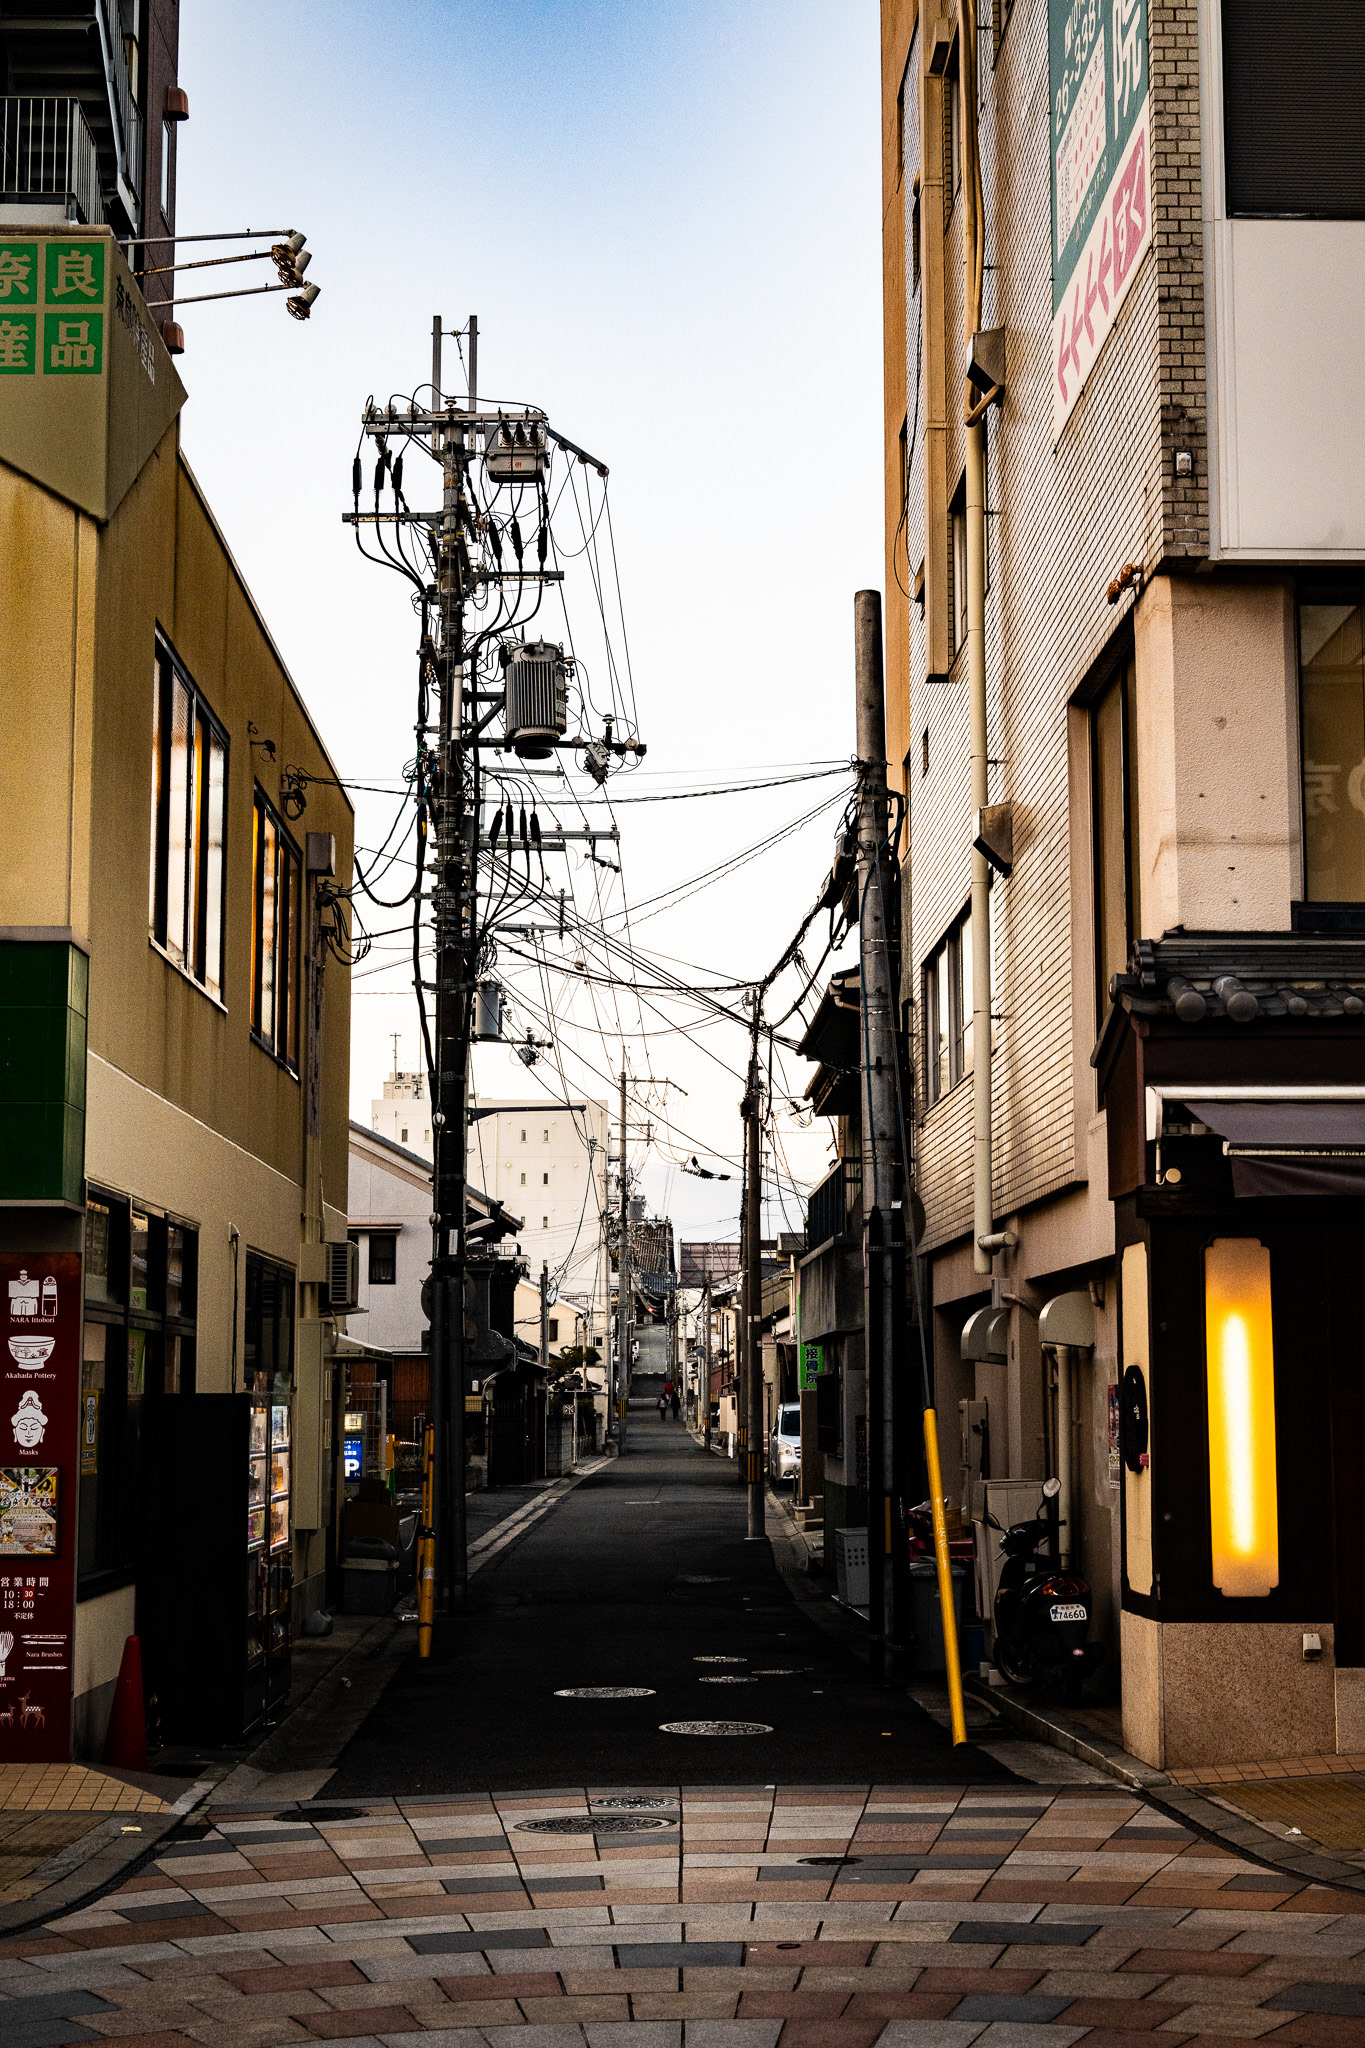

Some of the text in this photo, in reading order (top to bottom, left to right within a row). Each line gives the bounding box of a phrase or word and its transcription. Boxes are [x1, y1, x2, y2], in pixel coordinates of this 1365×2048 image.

[34, 1372, 57, 1380] Pottery
[344, 1458, 360, 1477] P
[0, 1576, 49, 1587] 営業時間
[3, 1600, 35, 1609] 18:00
[13, 1612, 35, 1620] 不定休
[1058, 1609, 1085, 1619] 74660
